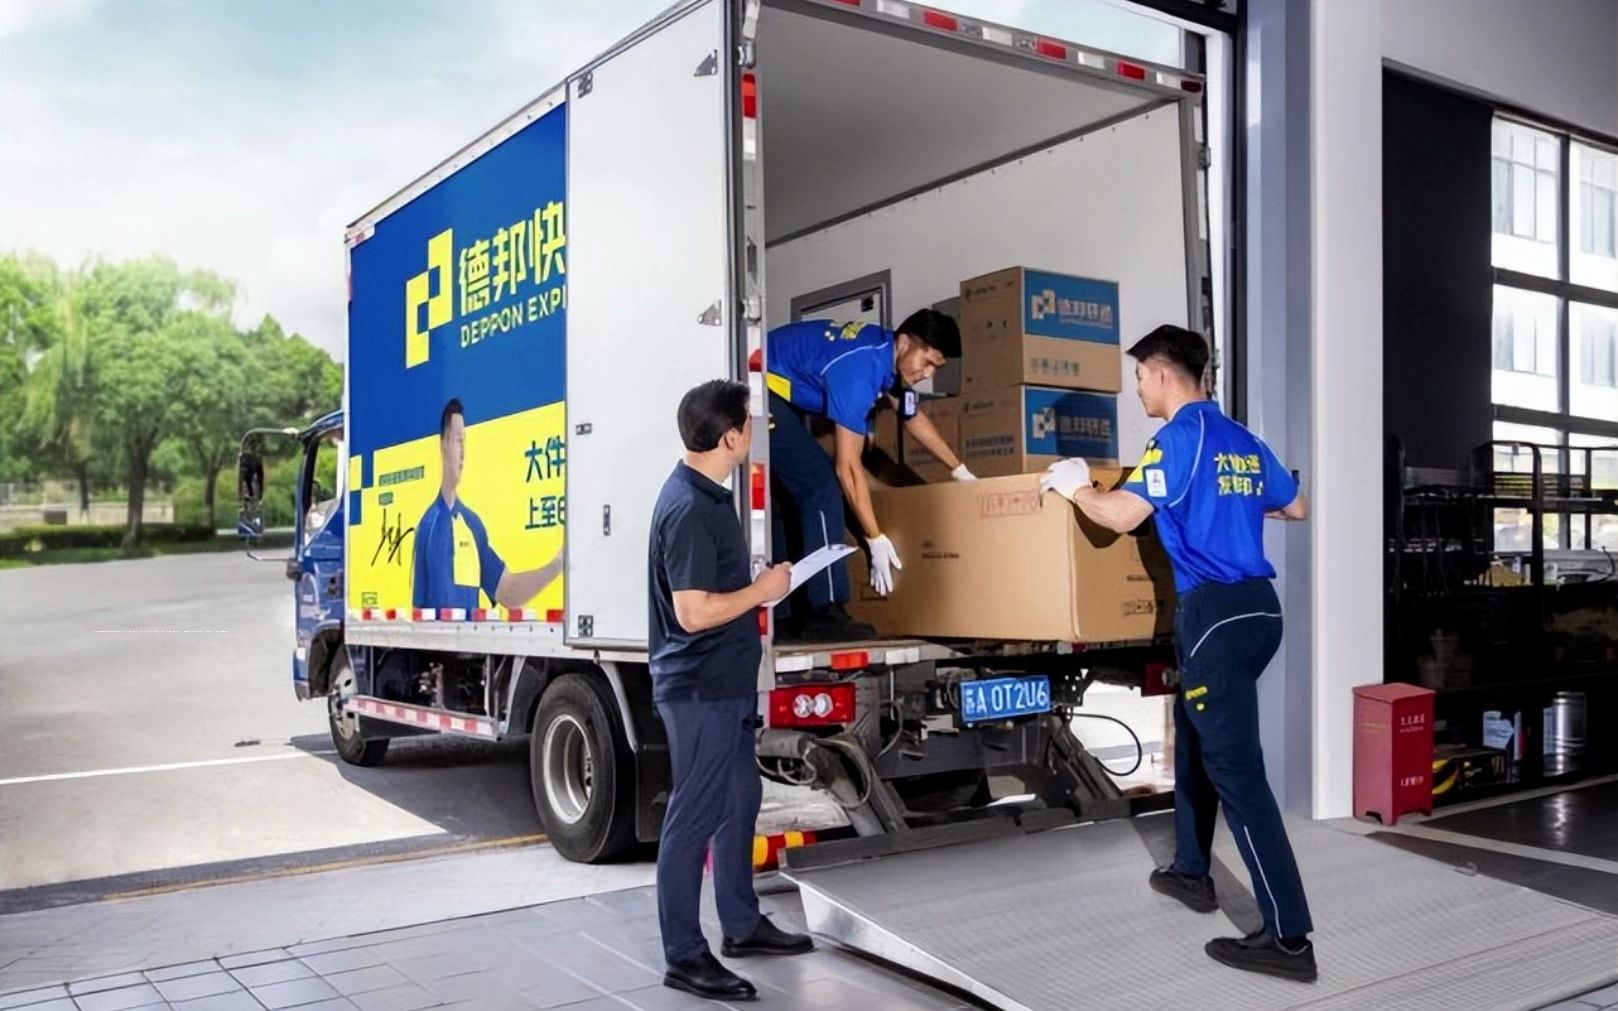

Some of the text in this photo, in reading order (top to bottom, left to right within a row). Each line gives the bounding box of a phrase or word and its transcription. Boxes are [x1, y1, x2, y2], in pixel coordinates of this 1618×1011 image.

[460, 283, 566, 348] DEPPON EXP
[524, 435, 566, 483] 大件
